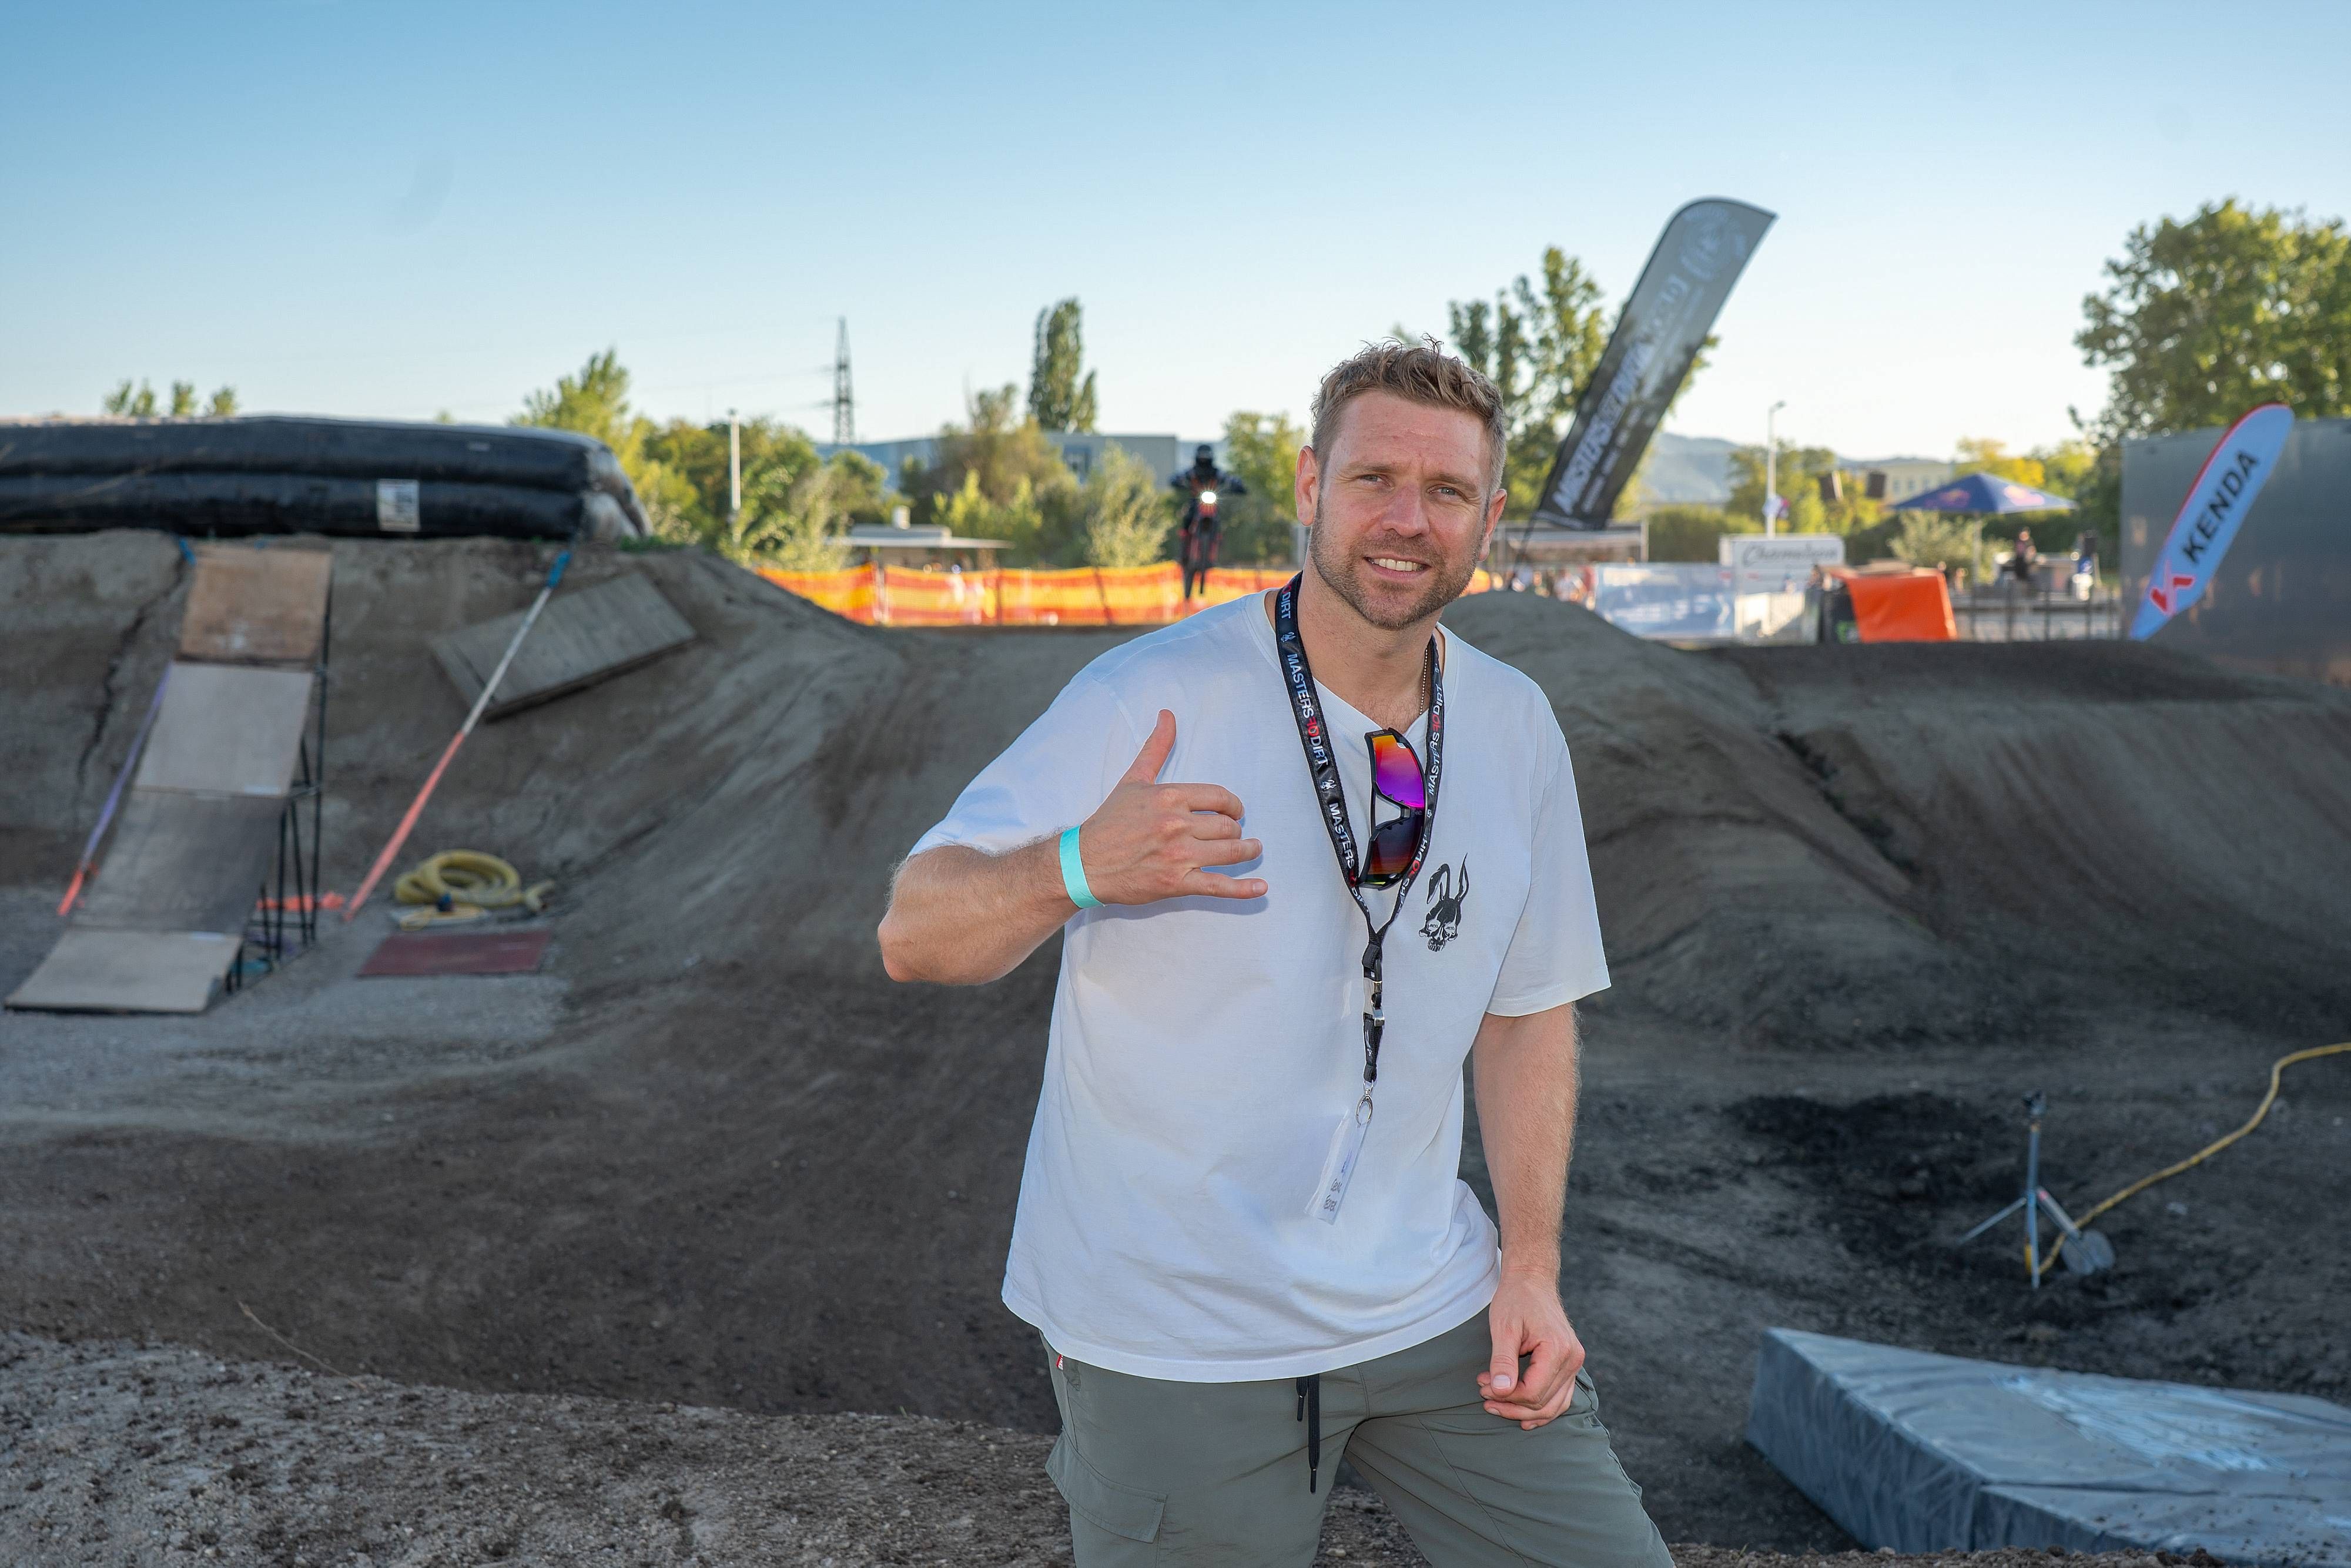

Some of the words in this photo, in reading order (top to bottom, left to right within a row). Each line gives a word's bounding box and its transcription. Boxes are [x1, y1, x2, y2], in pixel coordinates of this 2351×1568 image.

[2182, 450, 2258, 562] KENDA
[1281, 591, 1291, 619] DIRT
[1287, 654, 1314, 719] MASTERS
[1310, 736, 1328, 765] DIRT
[1427, 732, 1440, 796] MASTERS
[1329, 802, 1355, 869] MASTERS
